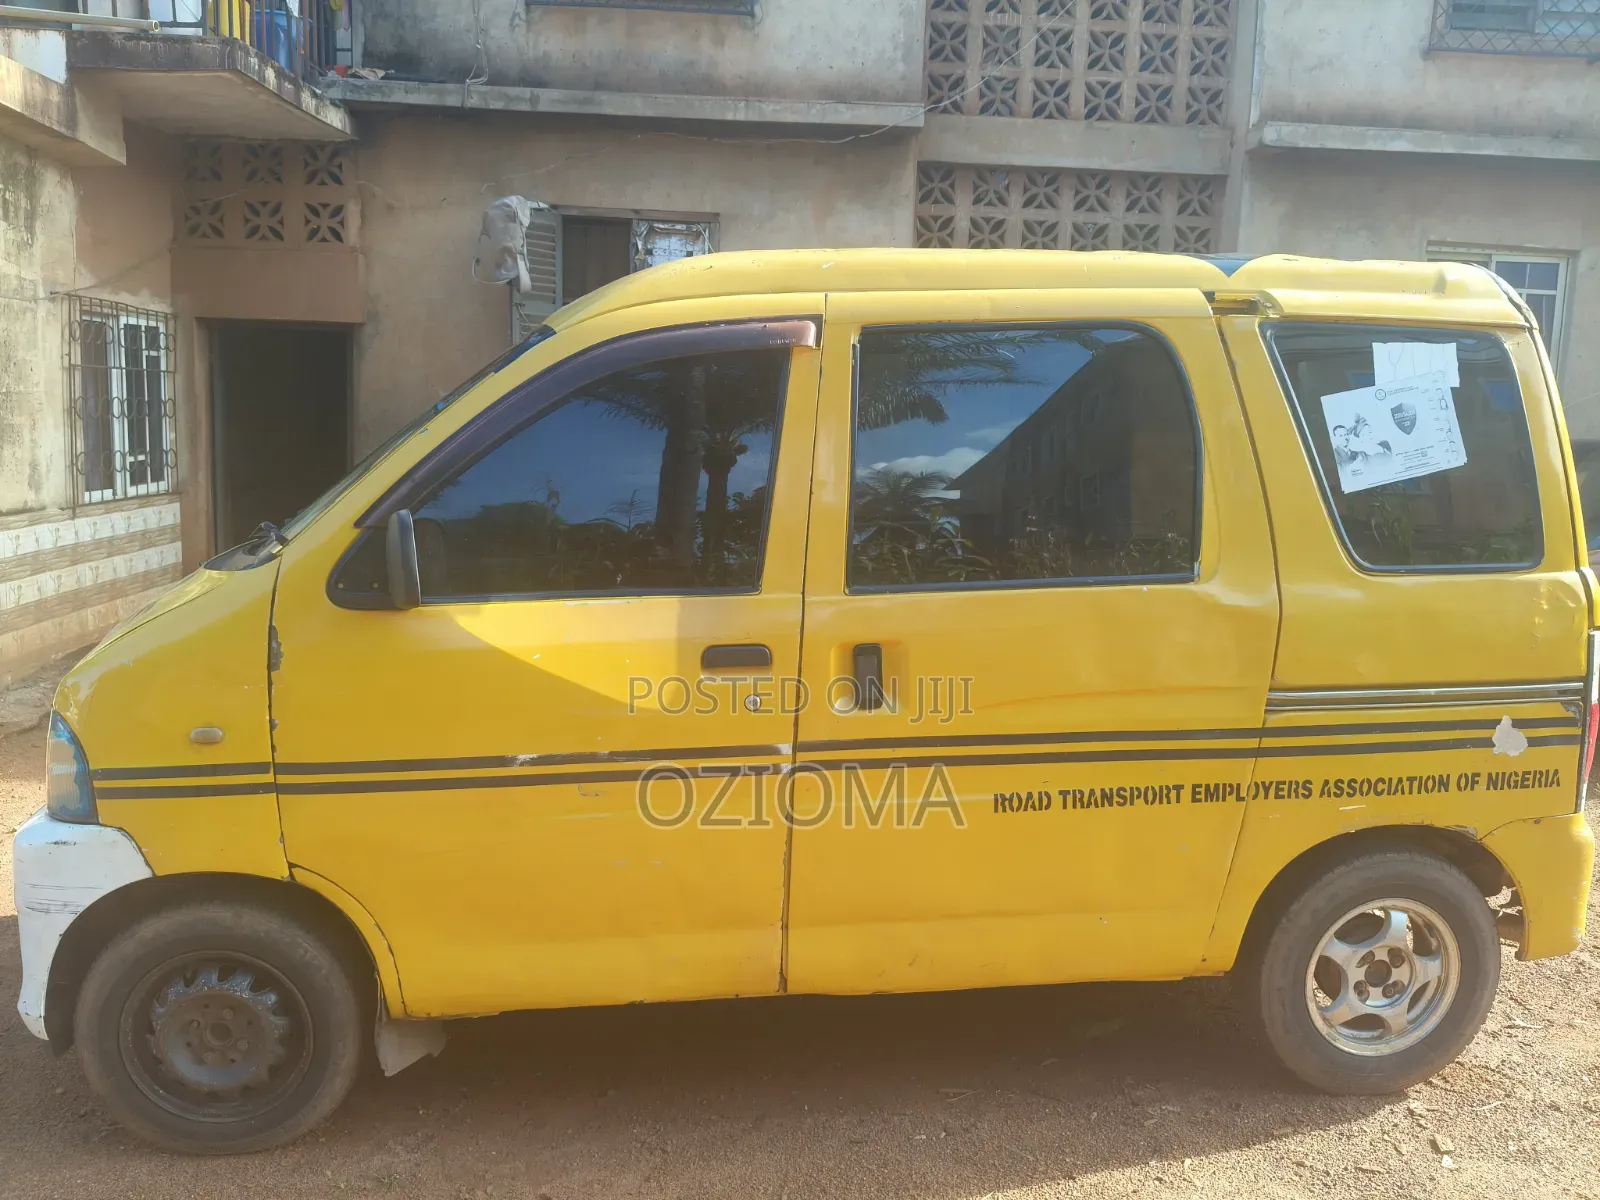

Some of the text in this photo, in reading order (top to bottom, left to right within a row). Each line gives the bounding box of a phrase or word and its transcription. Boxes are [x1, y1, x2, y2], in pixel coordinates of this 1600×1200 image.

[993, 768, 1561, 813] ROAD TRANSPORT EMPLOYERS ASSOCIATION OF NIGERIA
